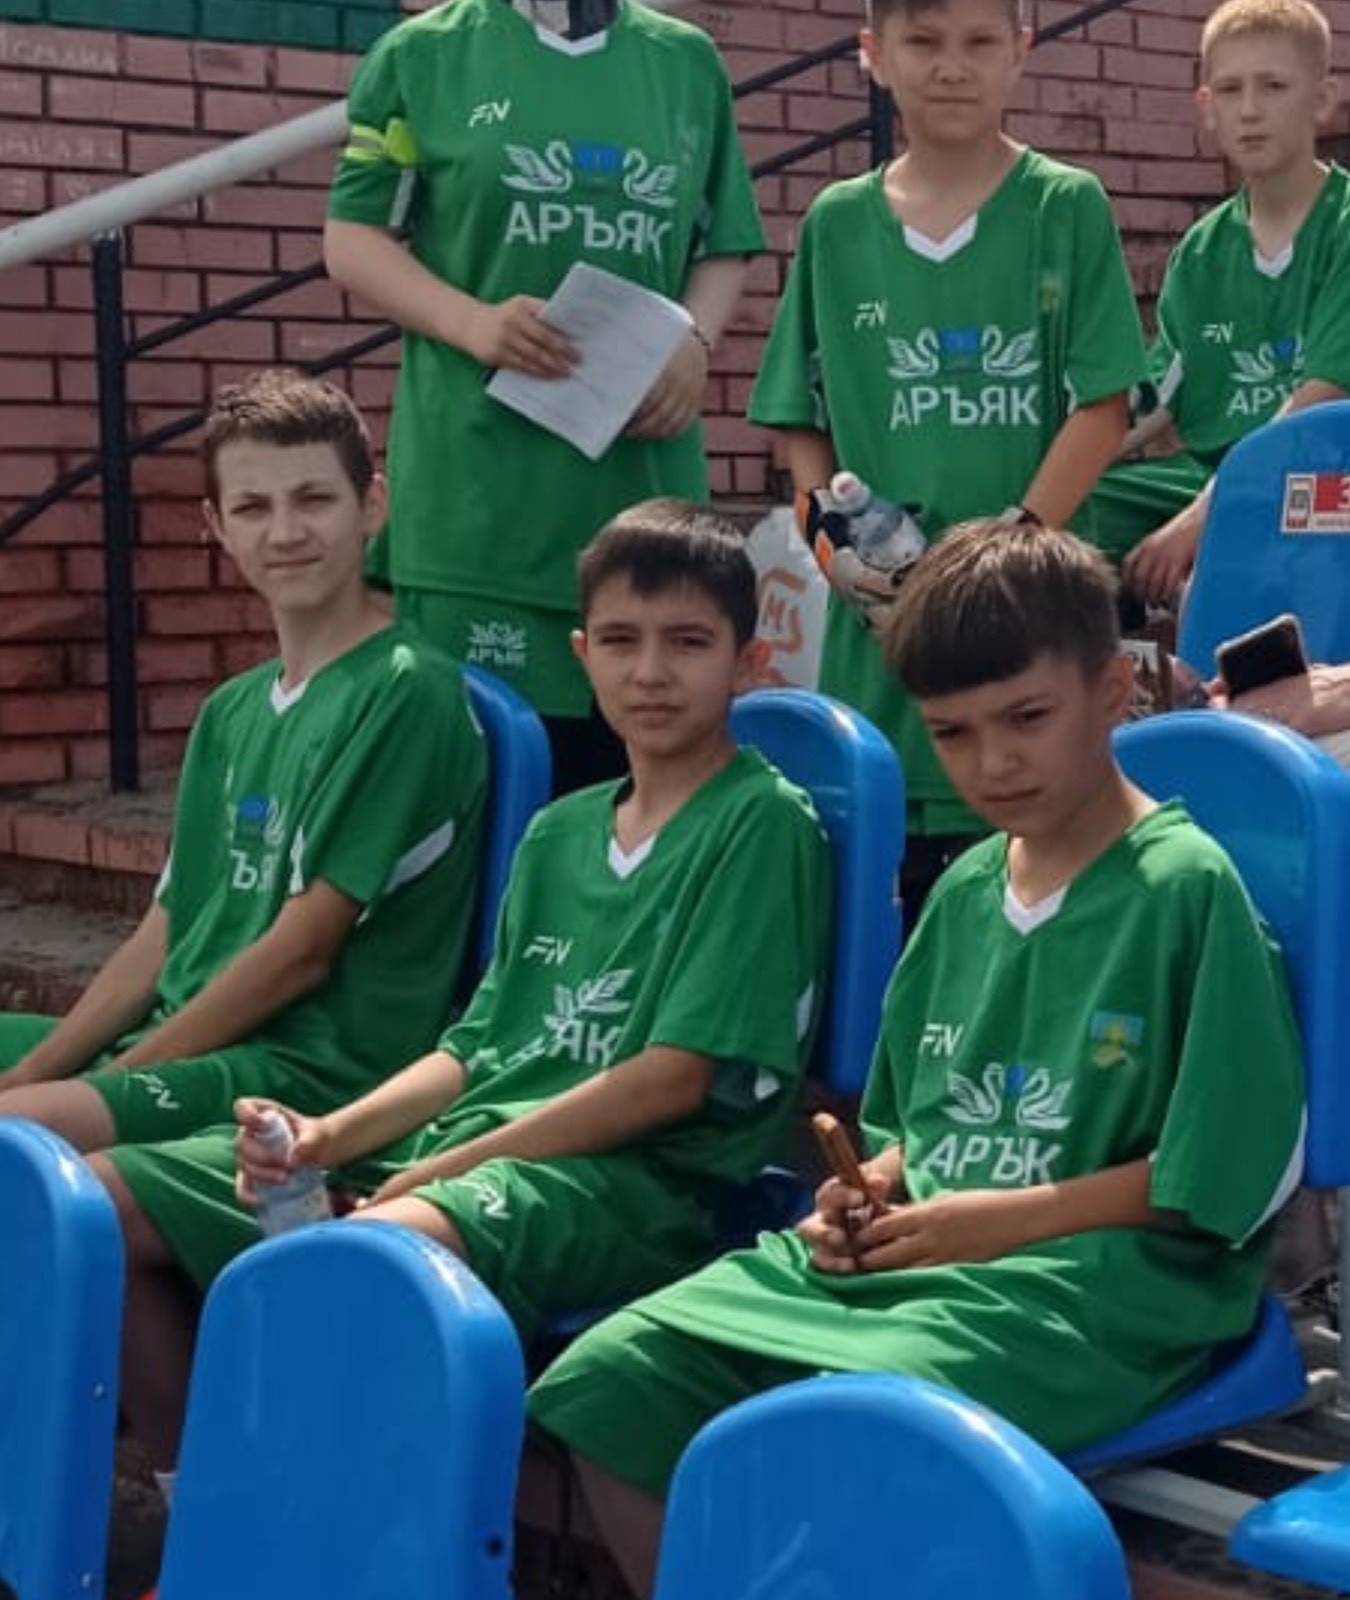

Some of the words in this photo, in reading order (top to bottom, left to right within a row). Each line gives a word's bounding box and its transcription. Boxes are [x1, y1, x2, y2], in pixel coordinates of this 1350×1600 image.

[467, 98, 511, 128] FN
[504, 201, 673, 263] АРЪЯК
[853, 299, 889, 332] FN
[889, 384, 1041, 431] АРЪЯК
[522, 935, 573, 965] FN
[918, 1022, 963, 1056] FN
[919, 1133, 1063, 1187] АРЪК
